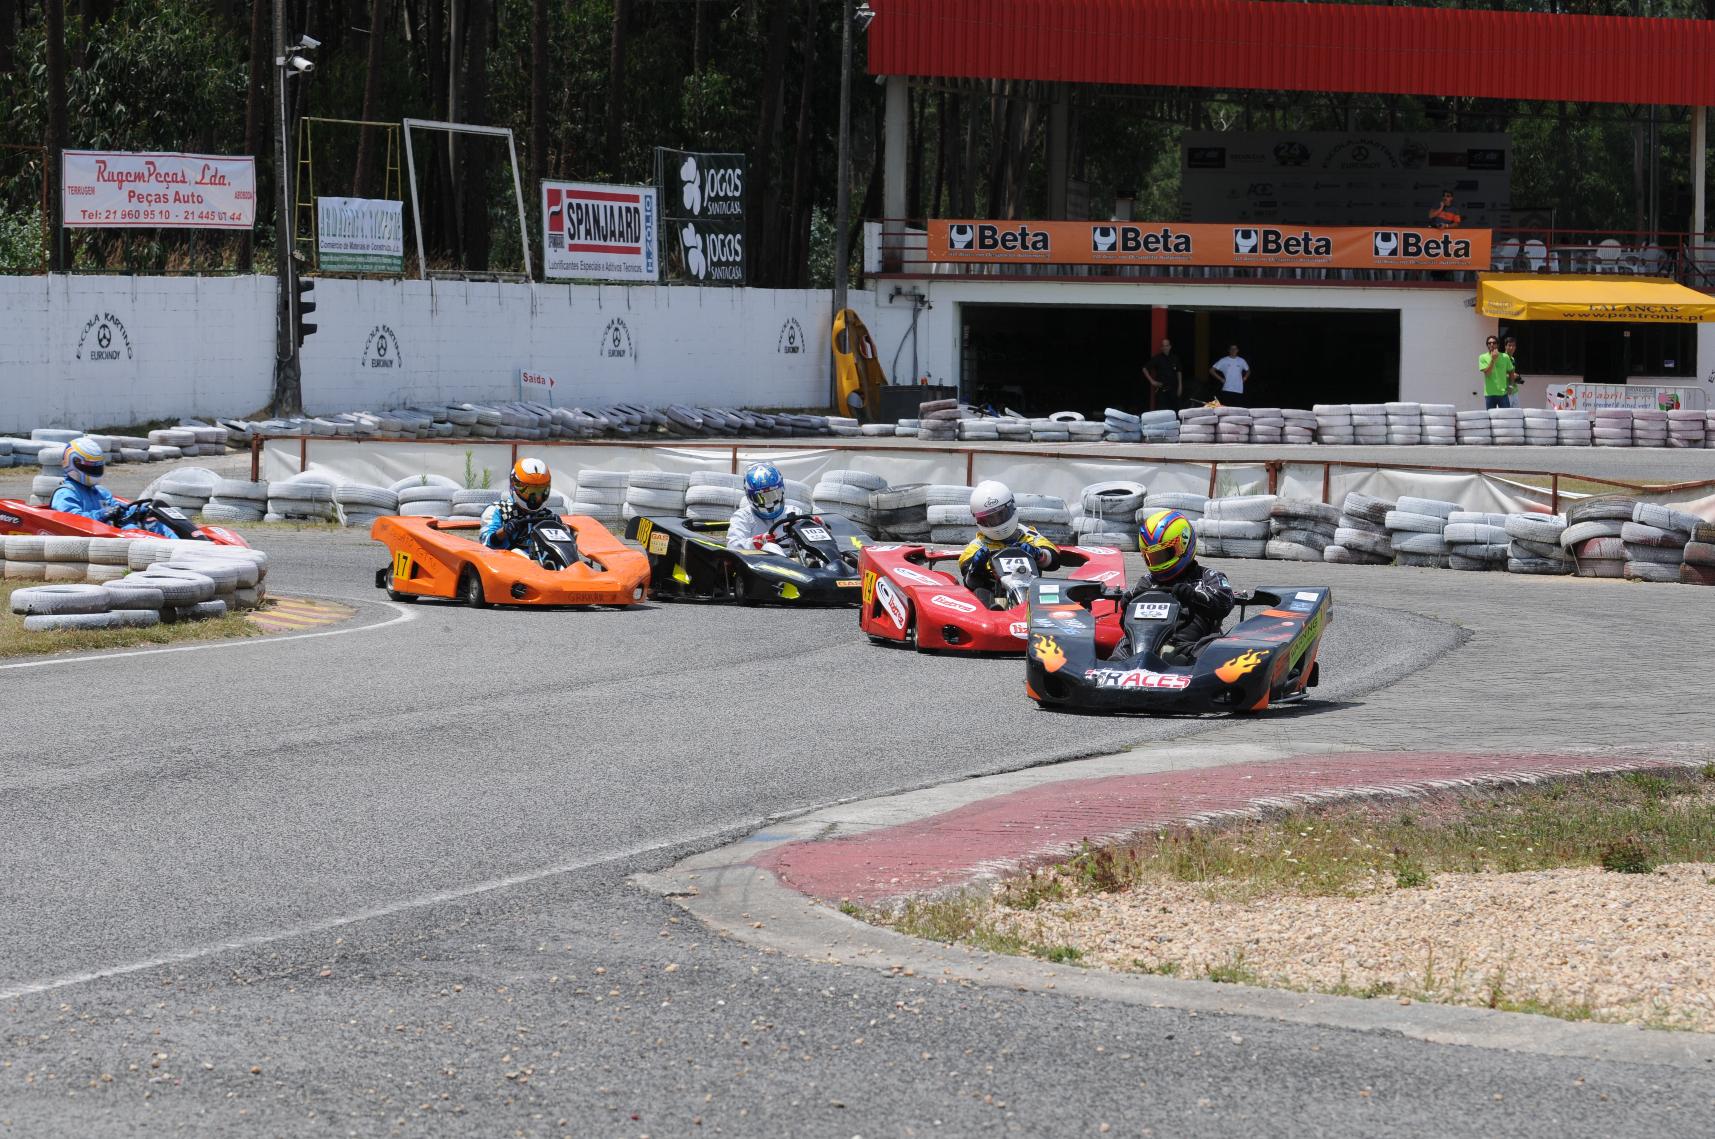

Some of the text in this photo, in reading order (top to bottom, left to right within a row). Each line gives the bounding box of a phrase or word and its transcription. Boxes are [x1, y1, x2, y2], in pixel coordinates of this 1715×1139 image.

[127, 189, 204, 207] Peças Auto
[704, 168, 742, 207] JOGOS
[80, 209, 102, 220] Tel:
[158, 210, 171, 220] 10
[183, 210, 195, 220] 21
[567, 201, 641, 243] SPANJAARD
[977, 223, 1050, 251] Beta
[1120, 226, 1193, 254] Beta
[1261, 229, 1332, 257] Beta
[1402, 232, 1472, 259] Beta
[706, 233, 742, 272] JOGOS
[396, 552, 408, 577] 17
